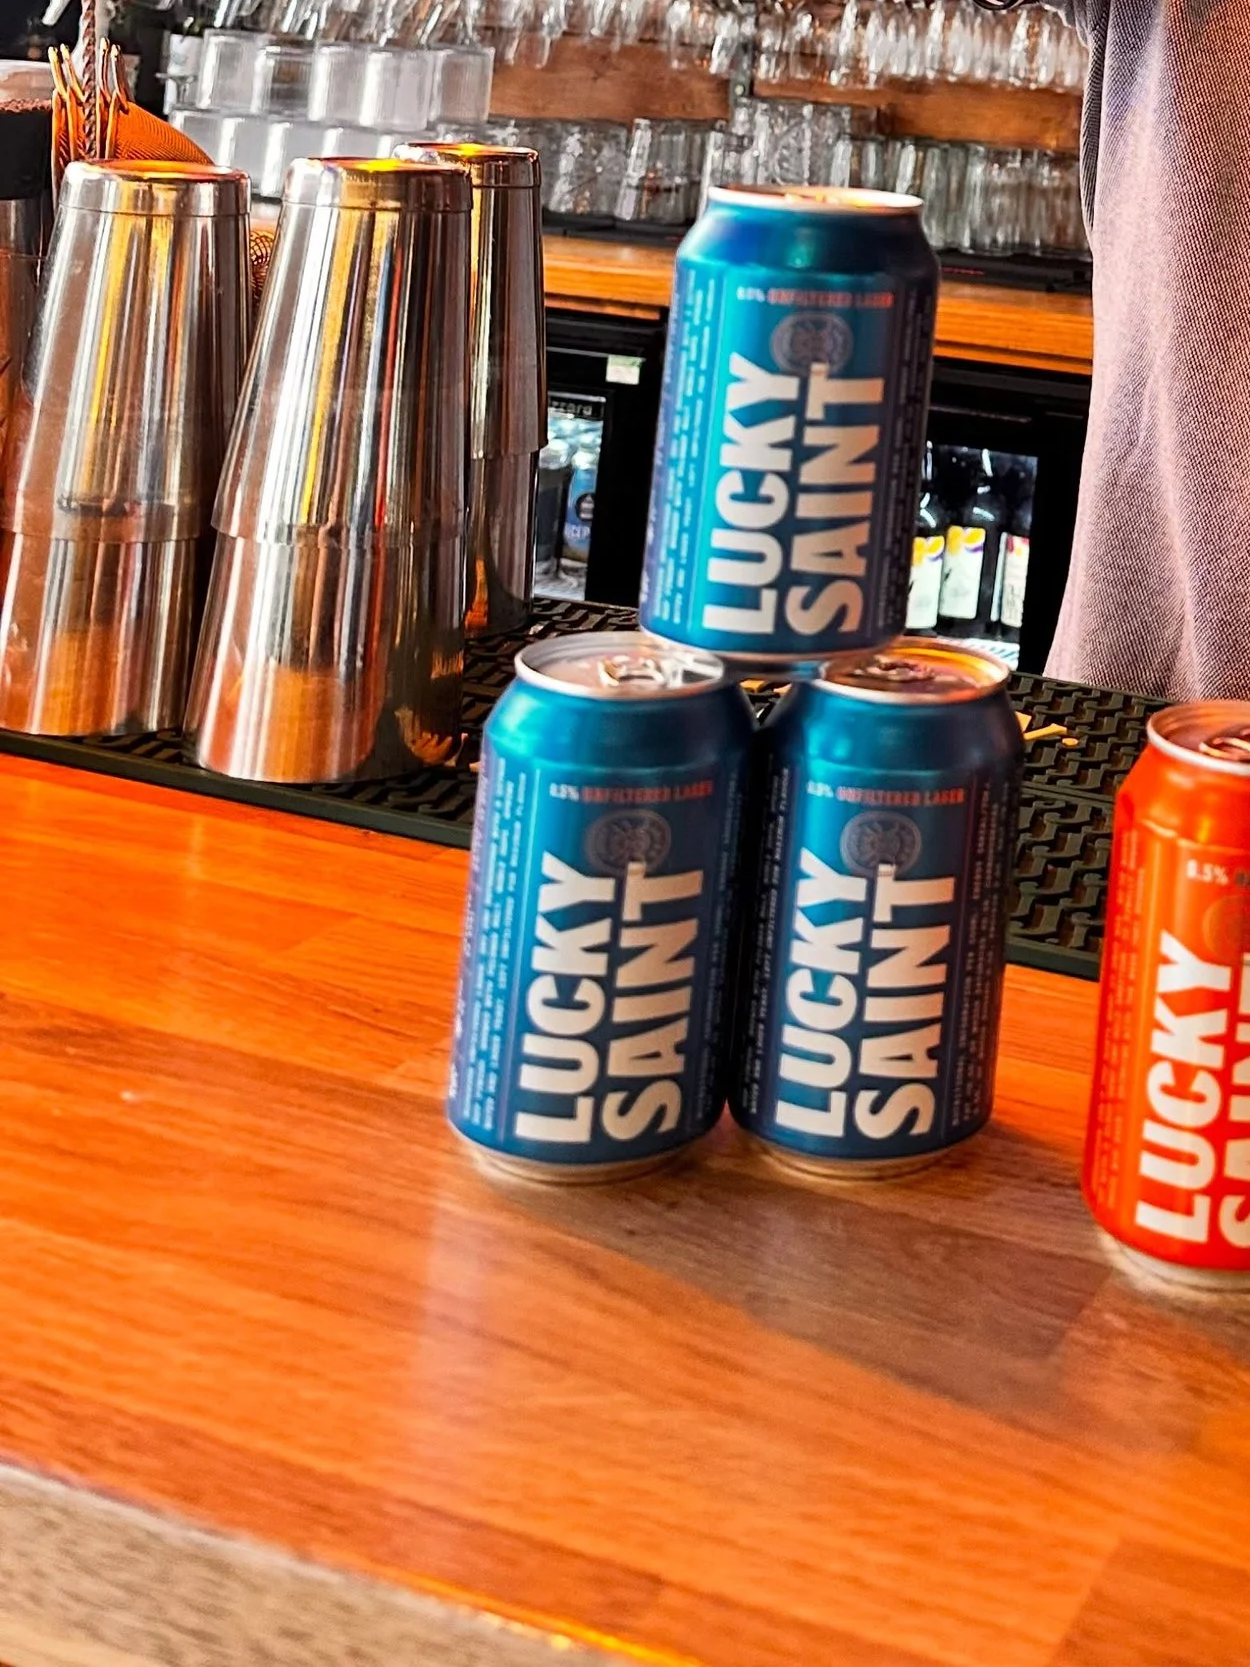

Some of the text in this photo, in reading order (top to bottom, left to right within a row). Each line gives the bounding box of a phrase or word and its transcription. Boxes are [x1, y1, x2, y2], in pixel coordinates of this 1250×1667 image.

[703, 353, 800, 634] LUCKY
[784, 362, 884, 637] SAINT
[515, 851, 616, 1143] LUCKY
[602, 861, 703, 1143] SAINT
[775, 846, 867, 1137] LUCKY
[854, 863, 956, 1140] SAINT
[1135, 929, 1231, 1244] LUCKY
